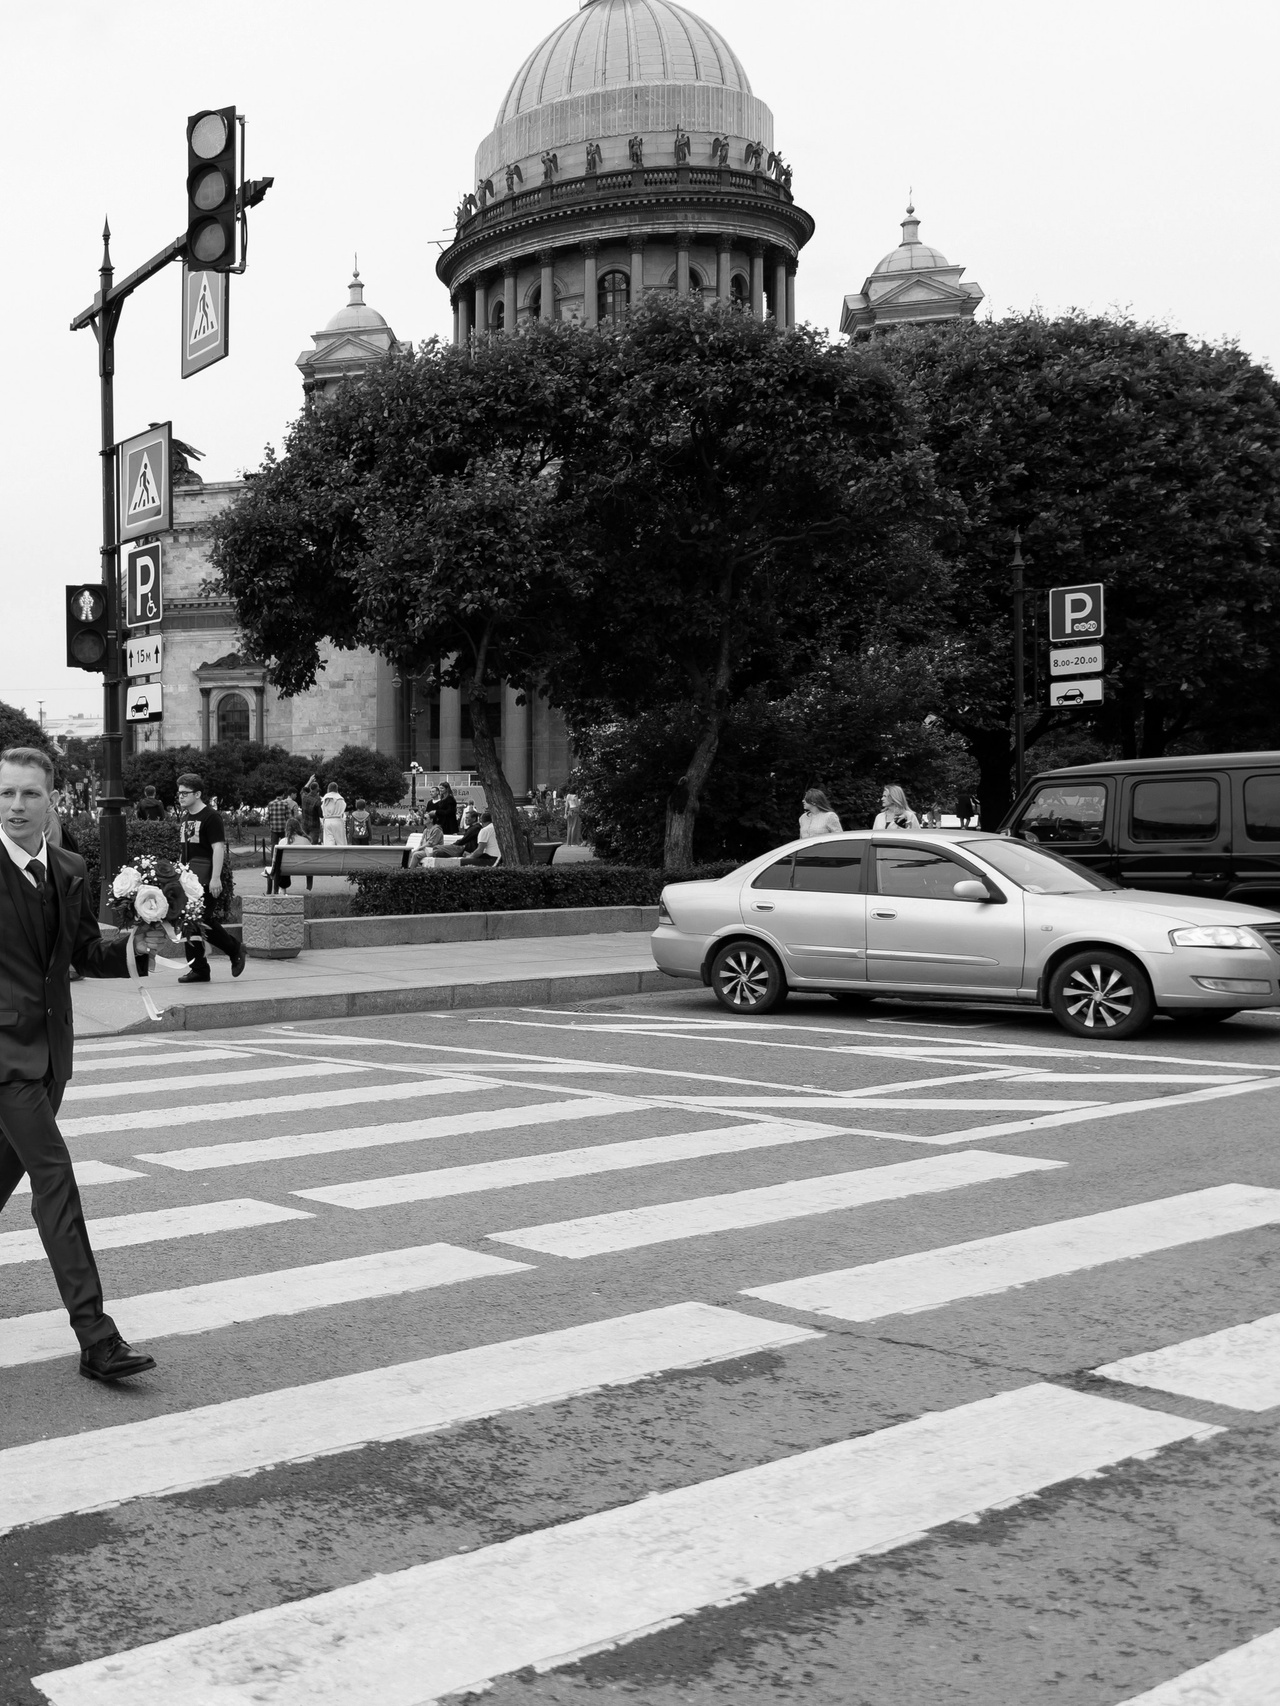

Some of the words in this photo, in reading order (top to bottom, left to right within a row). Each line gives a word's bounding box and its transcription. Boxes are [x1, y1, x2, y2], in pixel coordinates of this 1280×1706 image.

[136, 555, 155, 616] P
[1065, 592, 1093, 634] P
[1087, 622, 1096, 630] 20
[1053, 656, 1098, 668] 8.00-20.00
